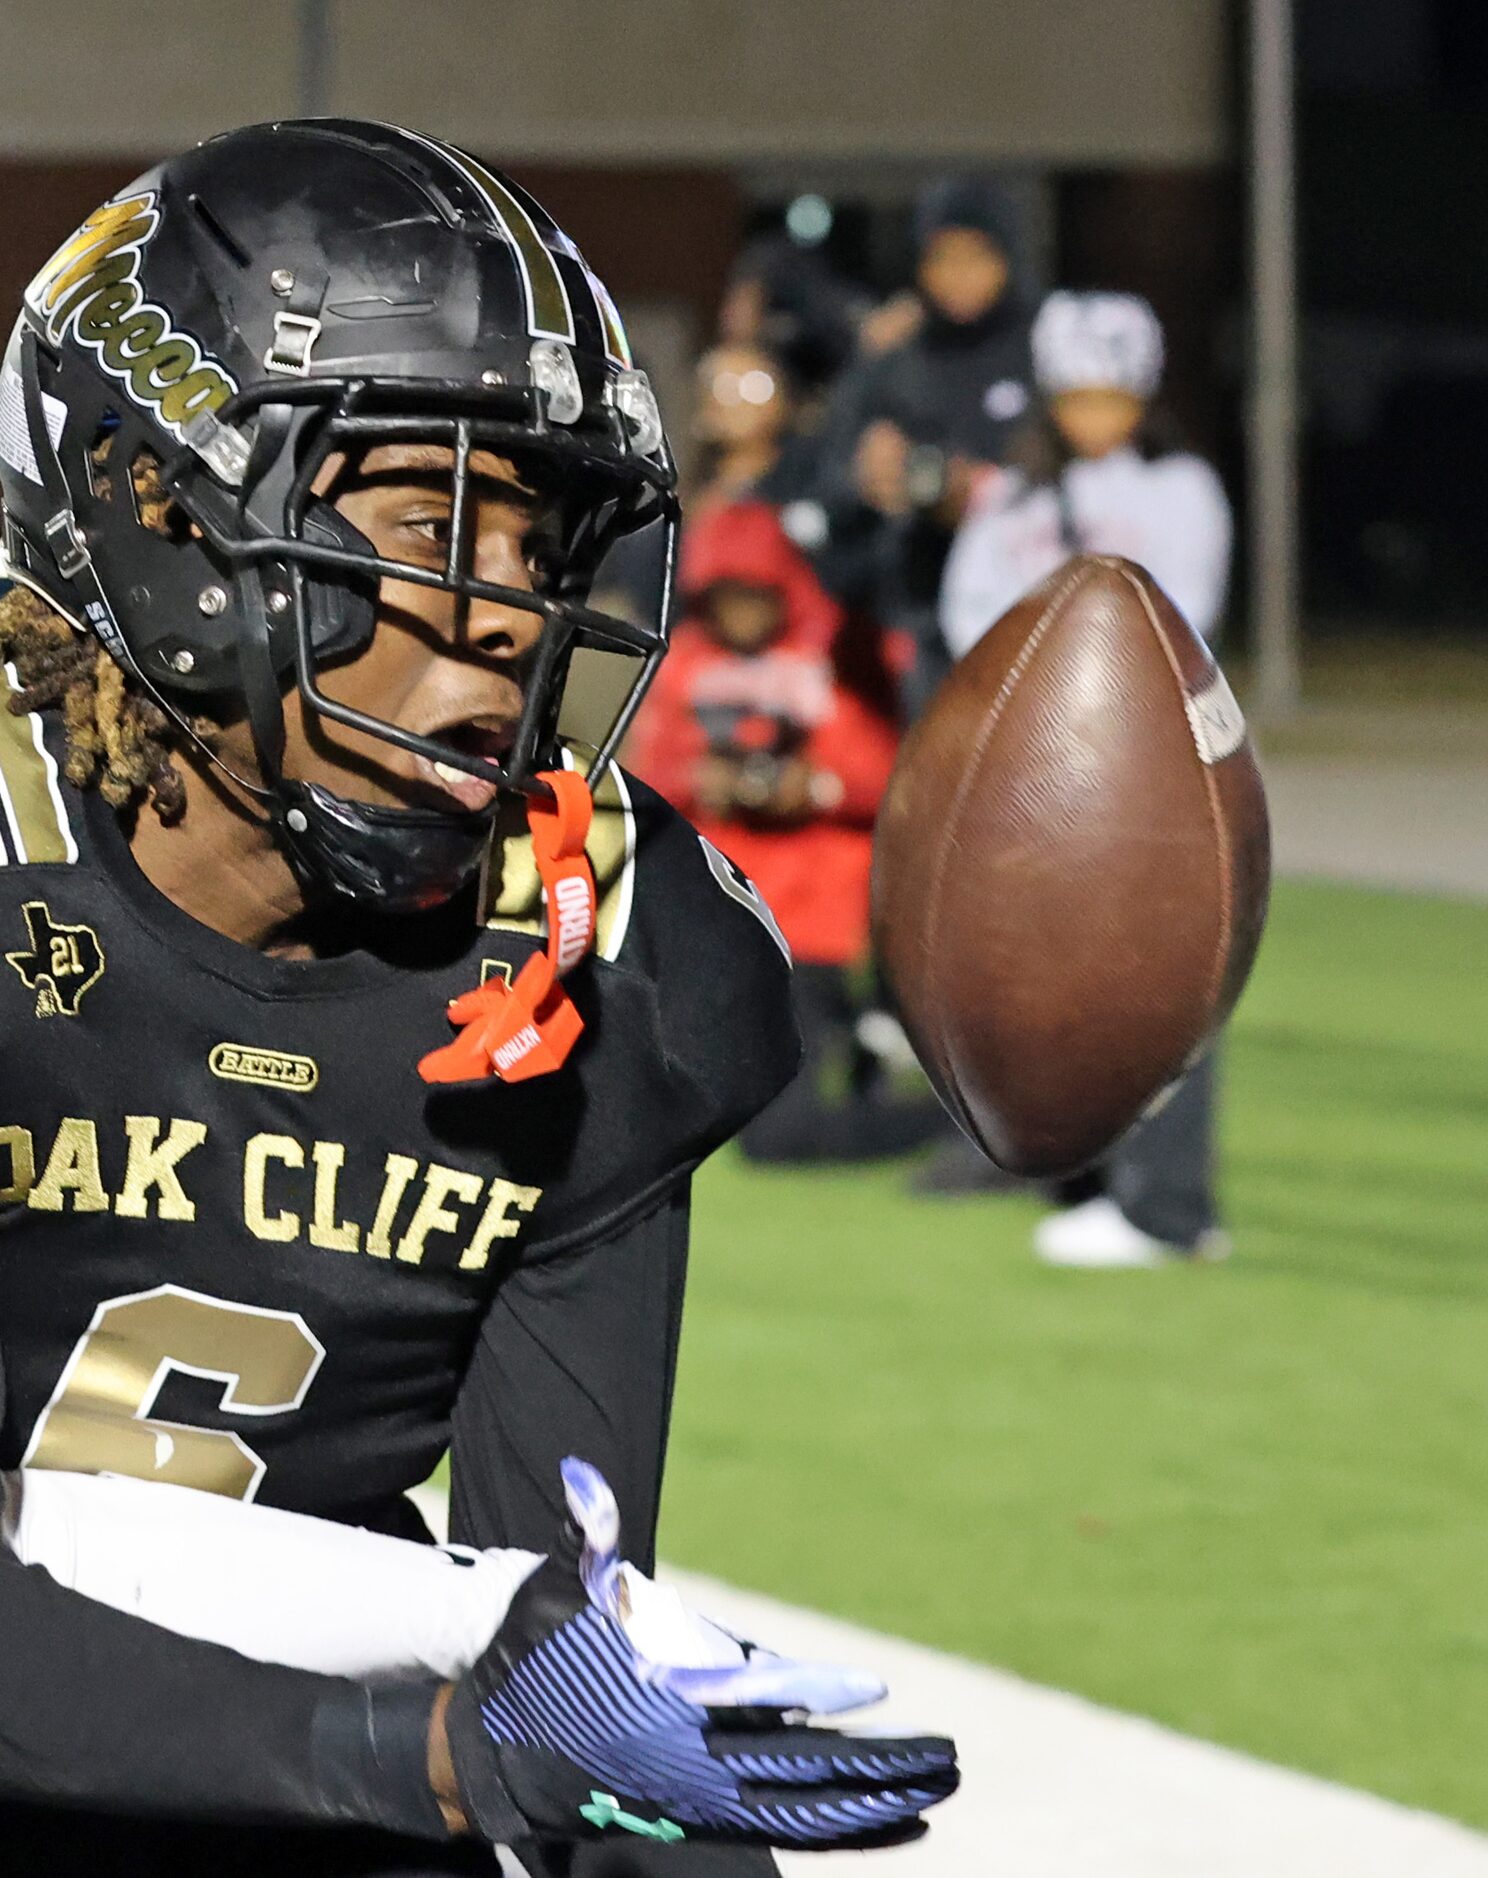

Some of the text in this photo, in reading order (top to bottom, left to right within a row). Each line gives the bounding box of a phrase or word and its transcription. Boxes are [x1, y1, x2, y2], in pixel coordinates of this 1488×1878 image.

[50, 935, 85, 977] 21
[219, 1049, 311, 1085] BATTLE
[494, 1023, 542, 1071] NXTRND
[243, 1131, 543, 1270] CLIFF
